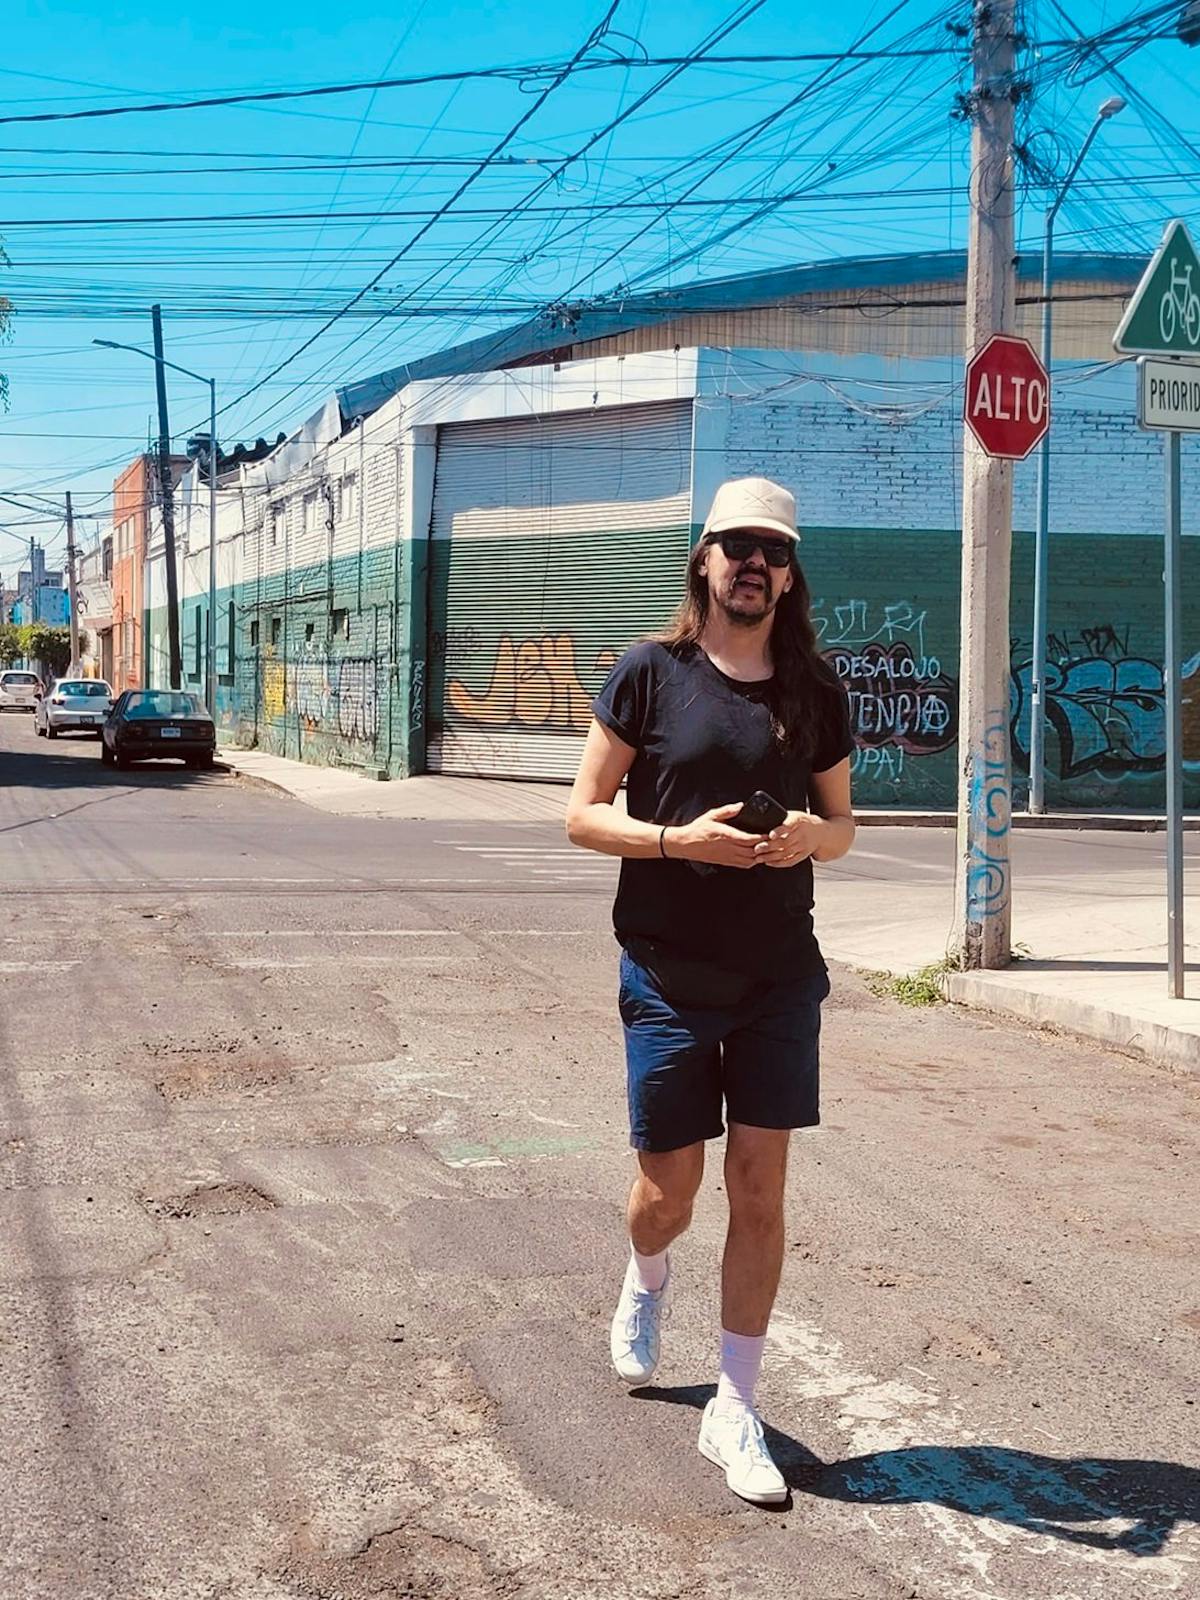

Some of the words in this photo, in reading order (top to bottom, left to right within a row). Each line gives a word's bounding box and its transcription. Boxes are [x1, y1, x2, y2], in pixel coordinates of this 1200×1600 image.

[973, 373, 1043, 425] ALTO
[1150, 378, 1200, 412] PRIORID
[835, 656, 941, 680] DESALOJO
